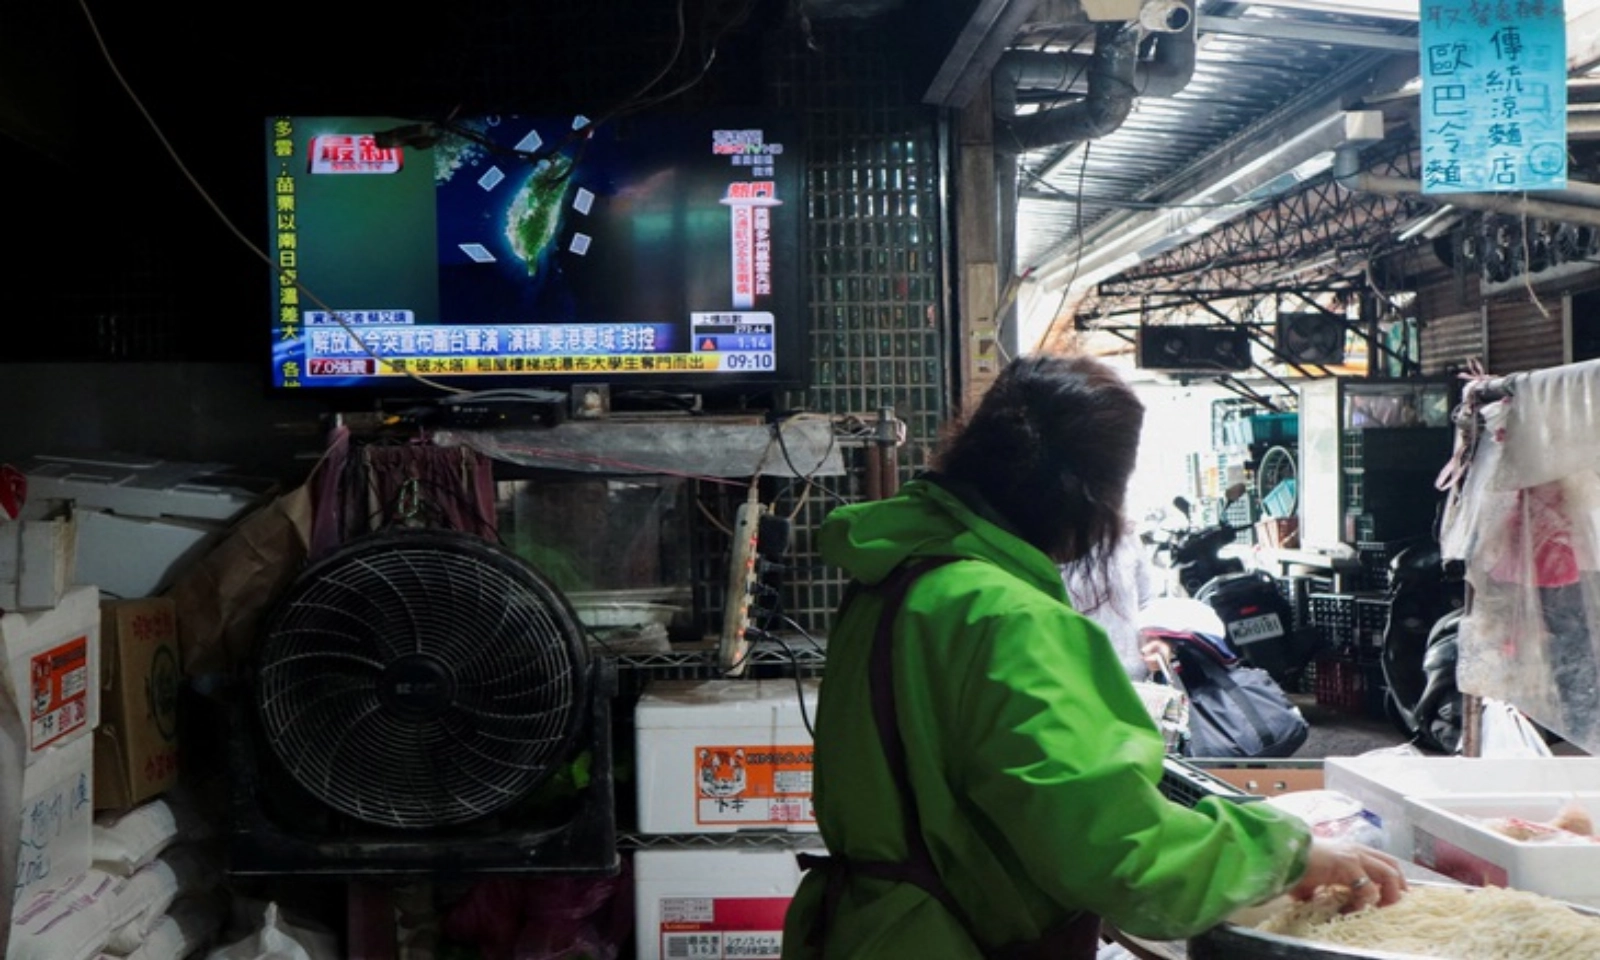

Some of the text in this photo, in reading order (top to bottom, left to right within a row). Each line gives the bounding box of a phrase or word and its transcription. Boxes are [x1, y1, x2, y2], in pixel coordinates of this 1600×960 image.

[1425, 42, 1473, 188] 歐巴冷麵
[1486, 26, 1524, 184] 傳統涼麵店
[320, 135, 394, 161] 最新
[738, 337, 767, 348] 1.14
[727, 354, 773, 369] 09:10
